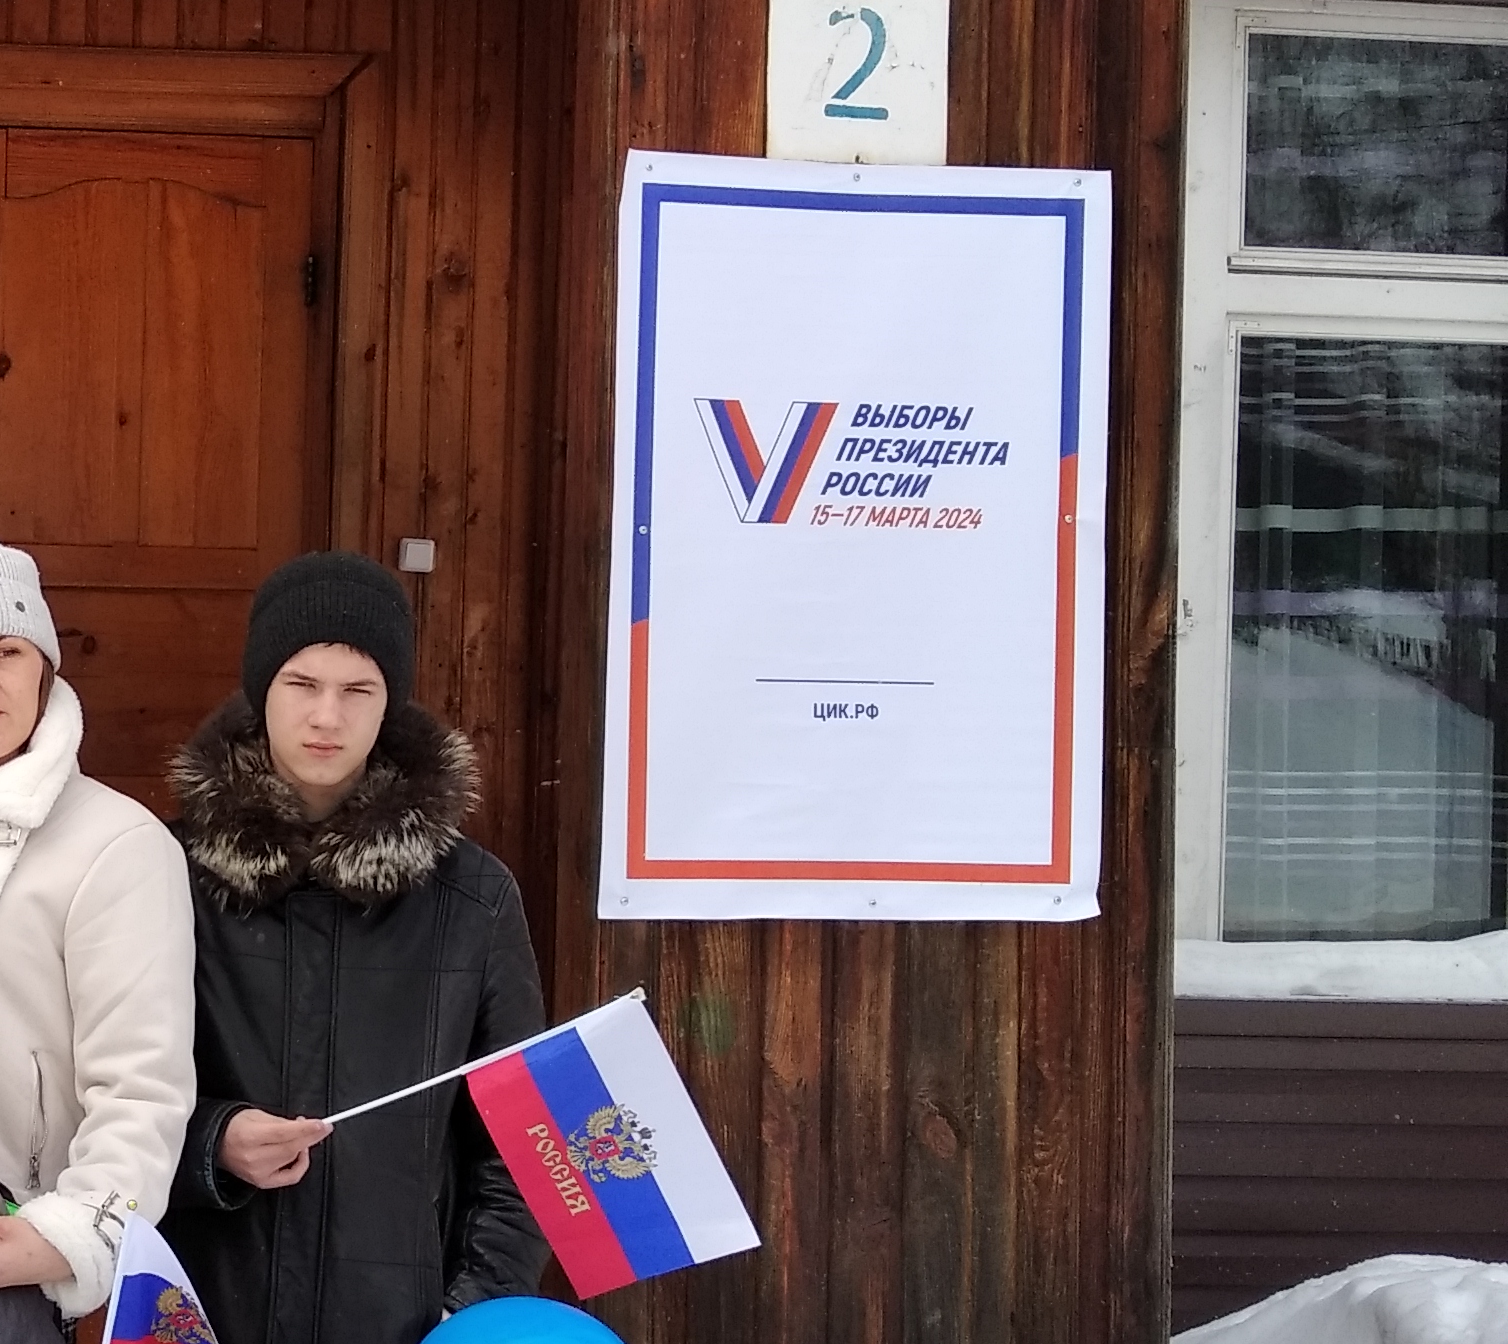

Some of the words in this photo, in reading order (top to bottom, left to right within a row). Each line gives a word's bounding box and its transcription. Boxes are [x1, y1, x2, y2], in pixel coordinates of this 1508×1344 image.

[823, 6, 890, 121] 2
[850, 403, 974, 431] ВЫБОРЫ
[835, 437, 1011, 468] ПРЕЗИДЕНТА
[820, 471, 933, 498] РОССИИ
[865, 506, 931, 528] МАРТА
[933, 508, 983, 529] 2024
[813, 703, 879, 722] ЦИК.РФ
[525, 1123, 591, 1217] РОССИЯ
